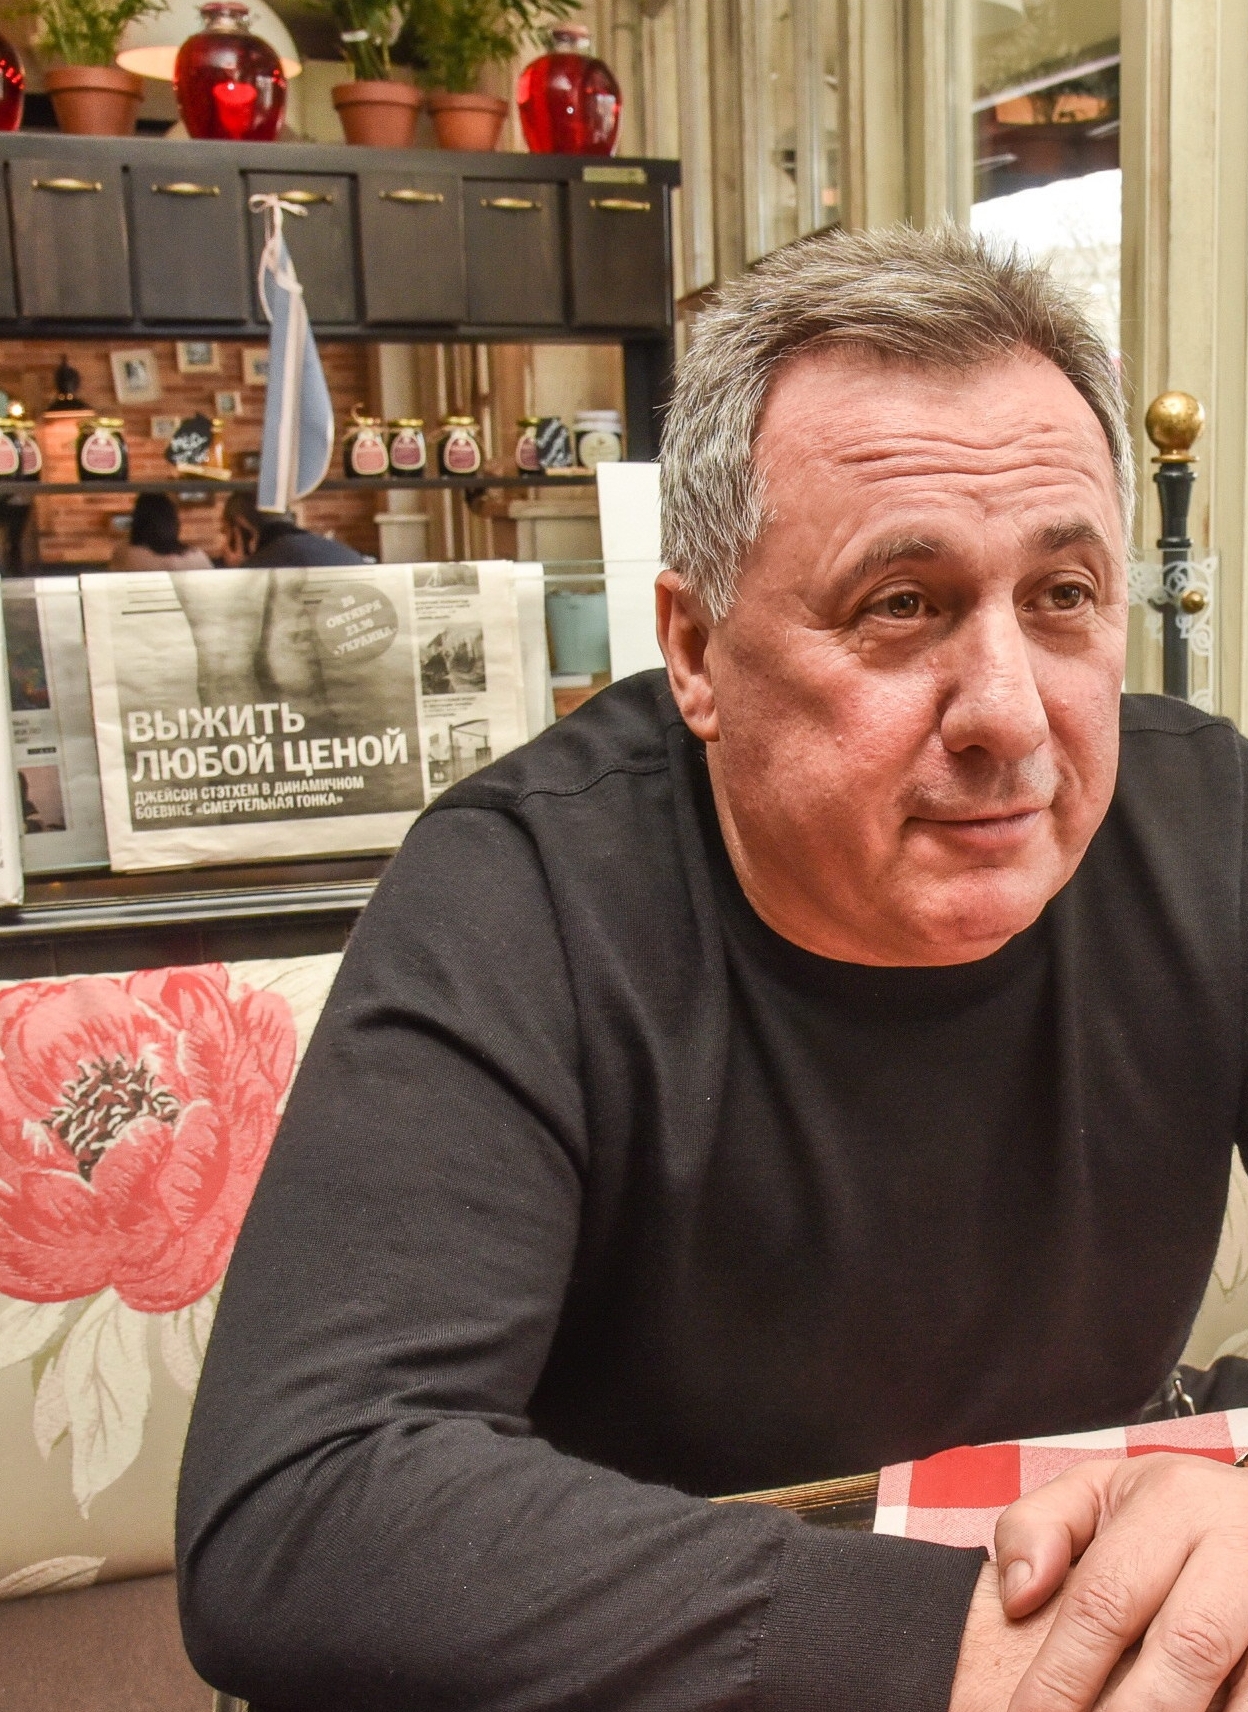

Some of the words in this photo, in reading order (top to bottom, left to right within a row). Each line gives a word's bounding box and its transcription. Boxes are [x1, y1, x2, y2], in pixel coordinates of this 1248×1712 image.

[128, 701, 306, 743] ВЫЖИТЬ
[131, 734, 275, 783] ЛЮБОЙ
[283, 726, 409, 777] ЦЕНОЙ
[134, 785, 198, 806] ДЖЕЙСОН
[201, 781, 259, 800] СТЭТХЕМ
[262, 781, 271, 795] В
[273, 775, 365, 794] ДИНАМИЧНОМ
[135, 803, 192, 821] БОЕВИКЕ
[196, 796, 295, 816] «СМЕРТЕЛЬНАЯ
[297, 792, 344, 809] ГОНКА»
